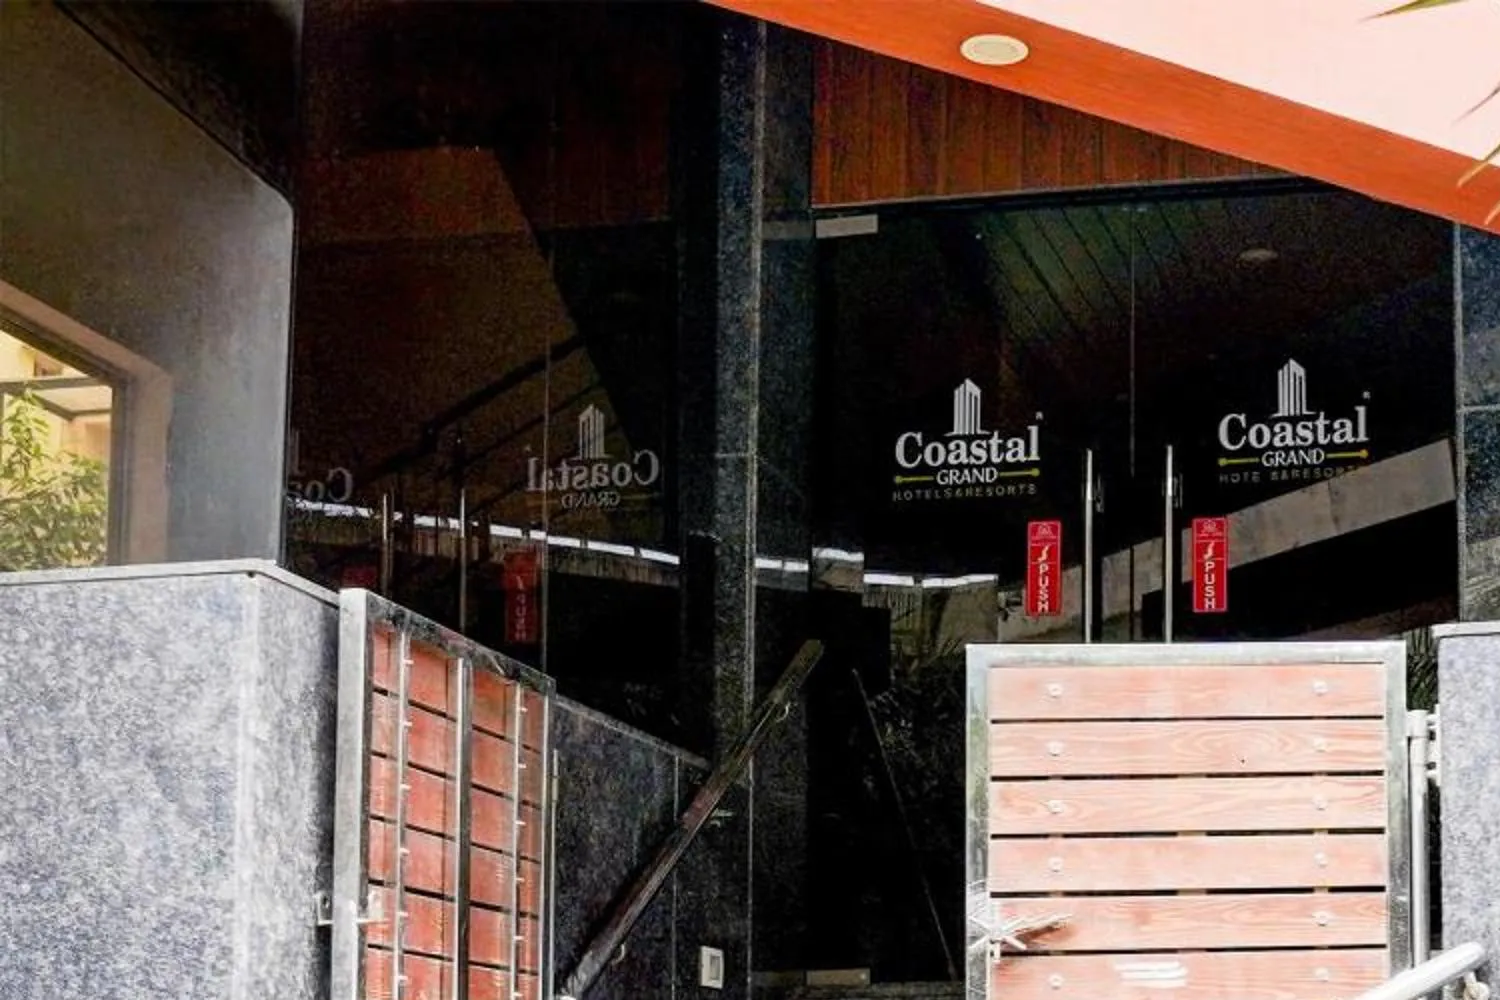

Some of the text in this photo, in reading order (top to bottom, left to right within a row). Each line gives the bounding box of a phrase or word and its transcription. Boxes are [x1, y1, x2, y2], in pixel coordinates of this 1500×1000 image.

[895, 425, 1041, 469] Coastal
[1218, 405, 1370, 451] Coastal
[936, 466, 999, 486] GRAND
[1261, 447, 1325, 467] GRAND
[1037, 563, 1050, 613] PUSH
[1205, 561, 1216, 610] PUSH
